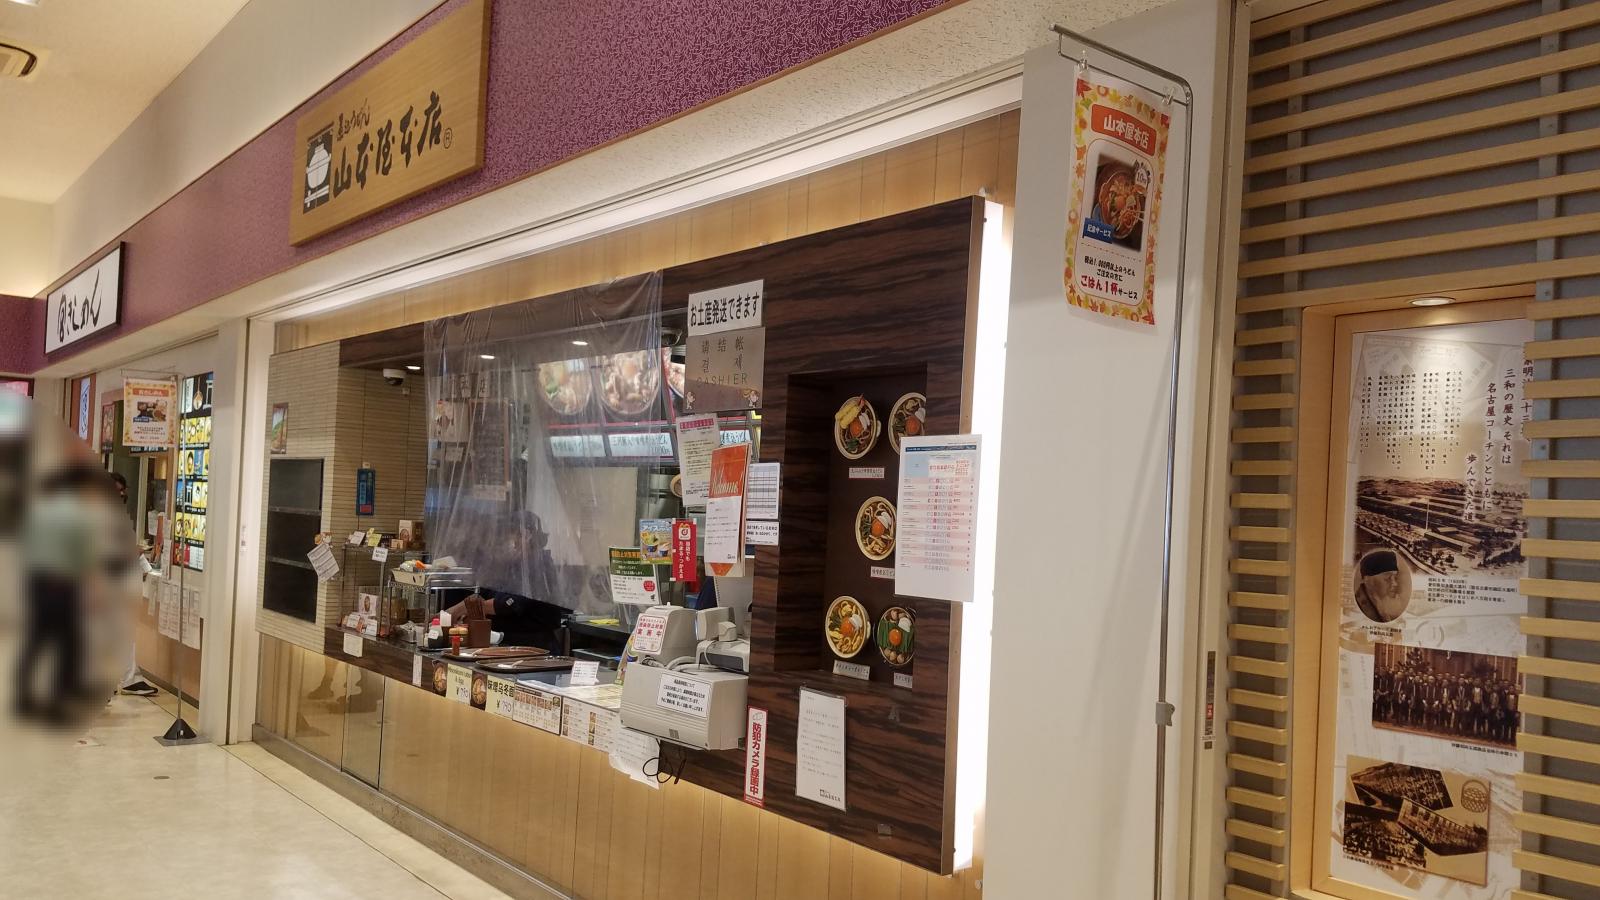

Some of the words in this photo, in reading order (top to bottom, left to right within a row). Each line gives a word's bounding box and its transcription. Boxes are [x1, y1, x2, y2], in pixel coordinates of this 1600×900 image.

[333, 90, 442, 198] 山本屋本店
[1103, 114, 1149, 149] 山本屋本店
[690, 292, 760, 327] お土産発送できます
[697, 373, 748, 387] CASHIER
[1481, 382, 1497, 512] 名古屋コーチンとともに
[1501, 431, 1513, 464] それは
[1464, 453, 1478, 523] 歩んできた道
[749, 722, 763, 795] 防犯カメラ録画中
